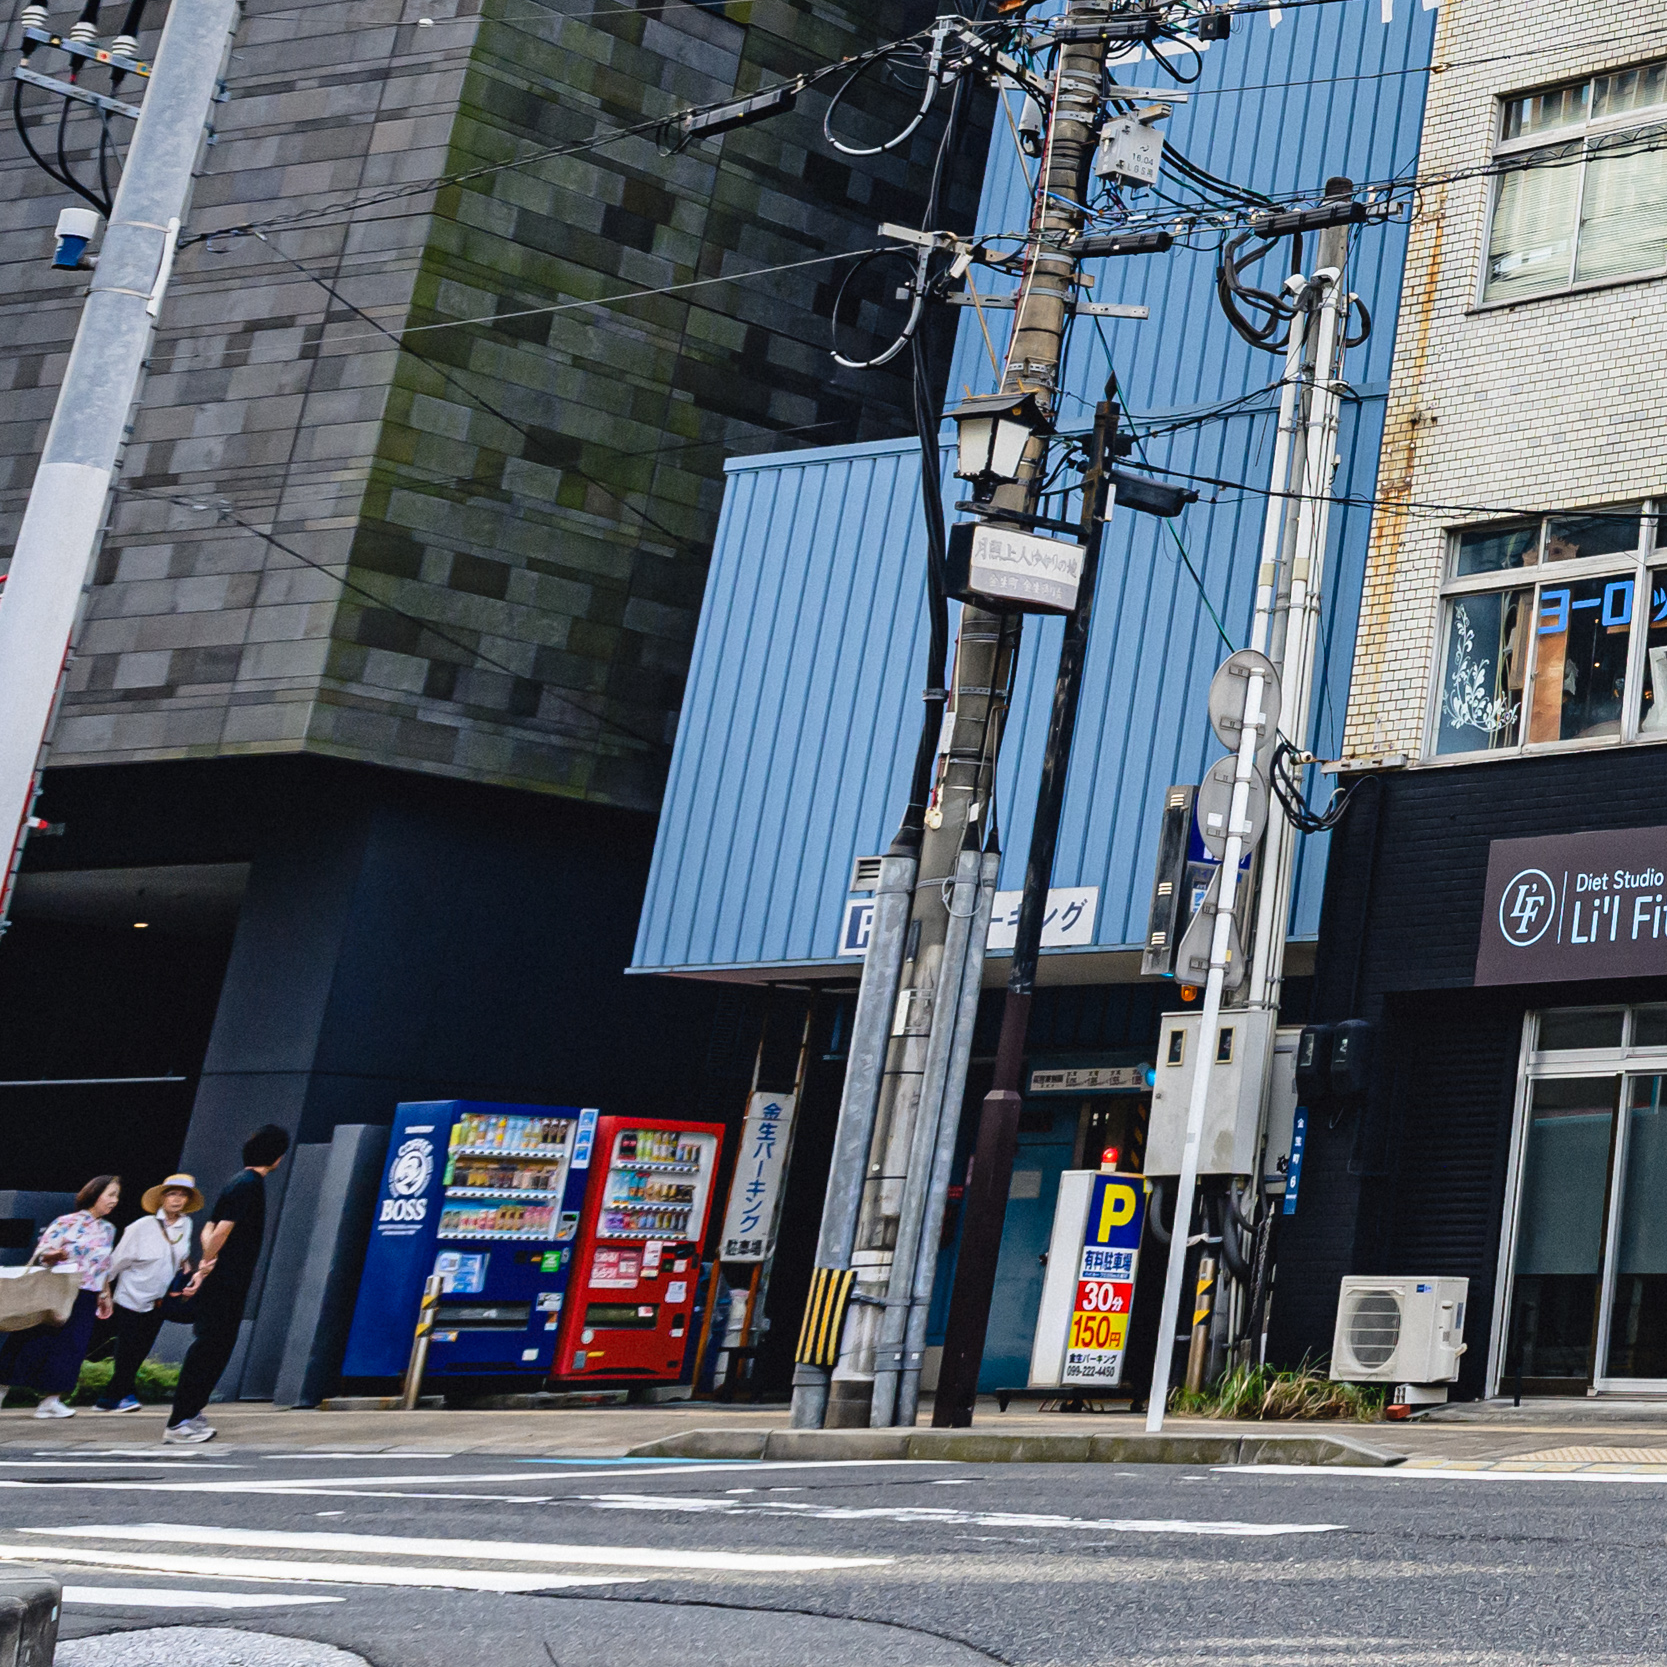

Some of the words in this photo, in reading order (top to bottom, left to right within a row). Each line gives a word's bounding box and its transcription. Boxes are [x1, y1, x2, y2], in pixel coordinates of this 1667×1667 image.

[1576, 873, 1609, 892] Diet
[1613, 868, 1664, 889] Studio
[990, 898, 1088, 933] ーキング
[1571, 895, 1620, 944] Li'l
[740, 1102, 782, 1233] 金生パーキング
[379, 1198, 428, 1221] BOSS
[1097, 1183, 1137, 1243] P
[725, 1238, 763, 1256] 駐車場
[1085, 1250, 1133, 1272] 有料駐車場
[1082, 1282, 1123, 1312] 30分
[1073, 1315, 1121, 1349] 150円
[1069, 1353, 1117, 1364] 金生パーキング
